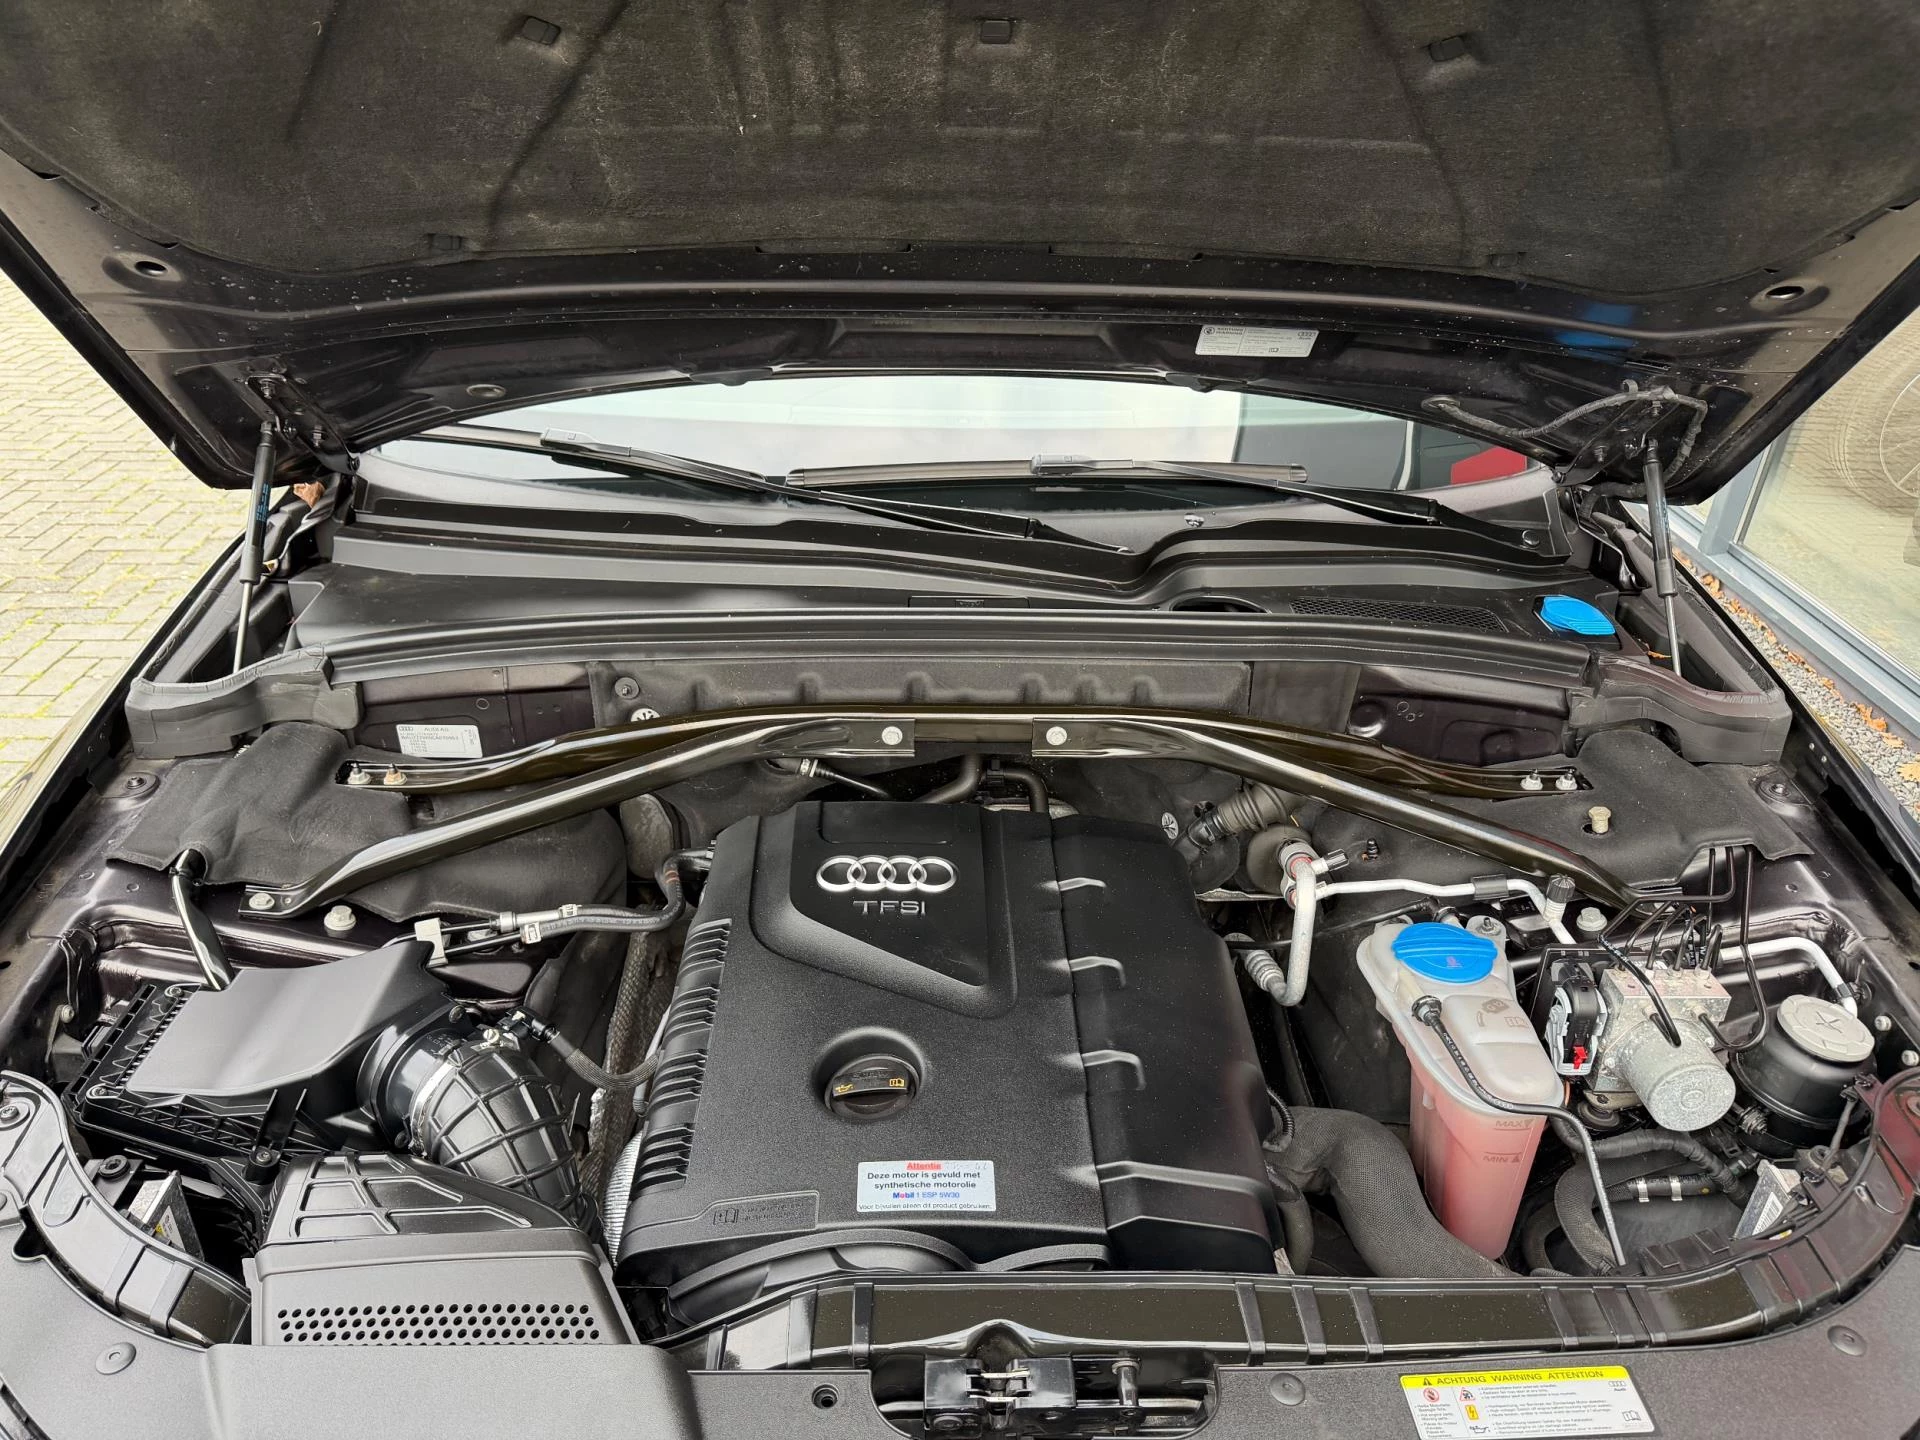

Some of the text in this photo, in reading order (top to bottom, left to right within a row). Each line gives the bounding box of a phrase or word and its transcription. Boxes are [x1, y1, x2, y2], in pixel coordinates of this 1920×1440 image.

[853, 900, 926, 916] TFSI
[1483, 1155, 1508, 1163] MIN
[867, 1172, 890, 1180] Deze
[921, 1171, 929, 1179] is
[931, 1171, 961, 1180] gevuld
[874, 1180, 976, 1190] synthetische motorolie
[892, 1191, 914, 1199] Mobil
[932, 1202, 958, 1210] product
[1437, 1370, 1604, 1386] ACHTUNG WARNING ATTENTION
